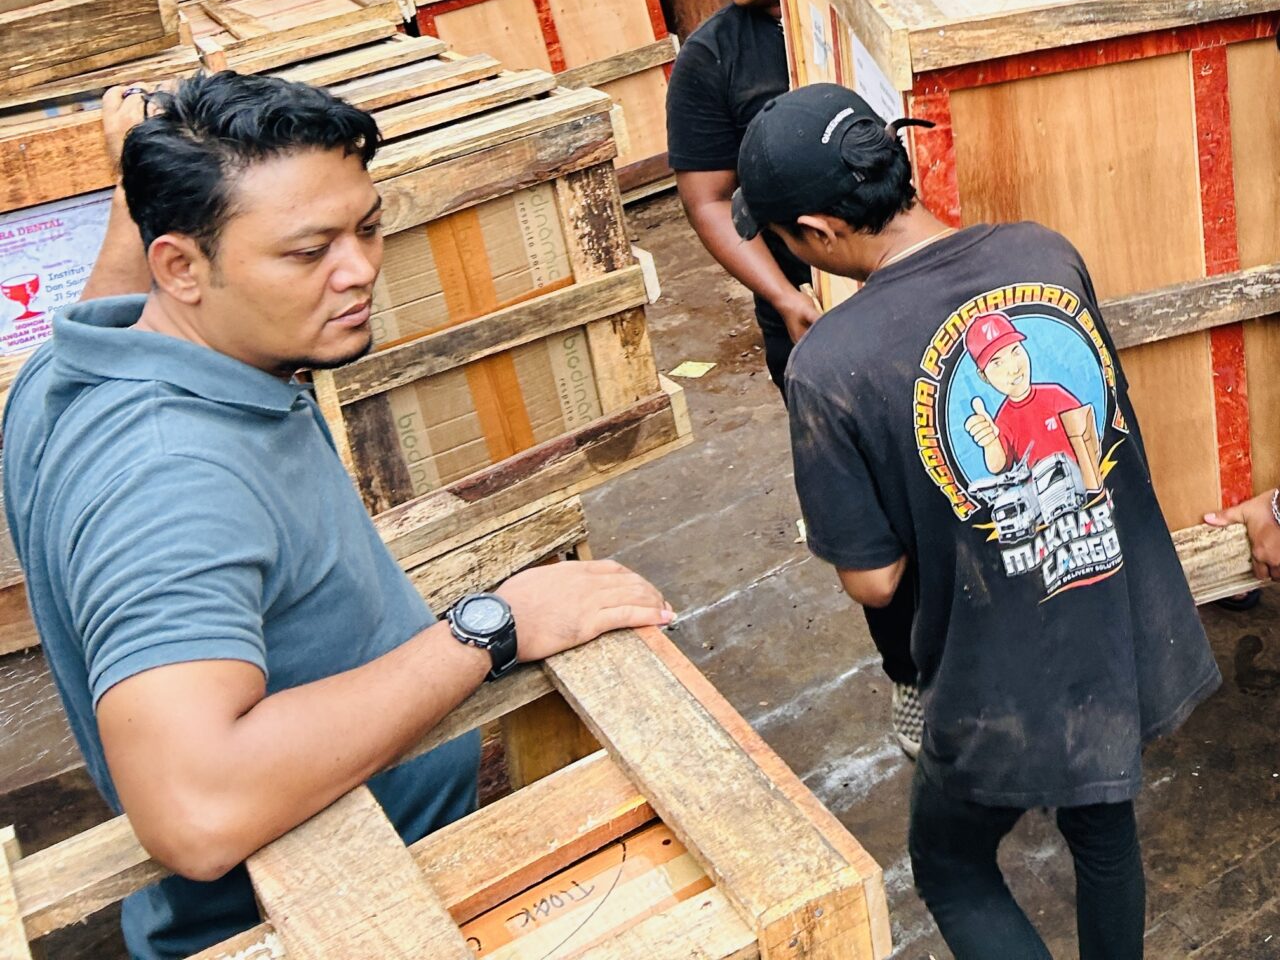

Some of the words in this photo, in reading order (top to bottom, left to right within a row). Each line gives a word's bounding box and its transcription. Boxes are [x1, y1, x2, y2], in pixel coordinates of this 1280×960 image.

[17, 218, 64, 237] DENTAL
[921, 283, 1080, 378] PENGIRIMAN
[1042, 528, 1121, 588] CARGO
